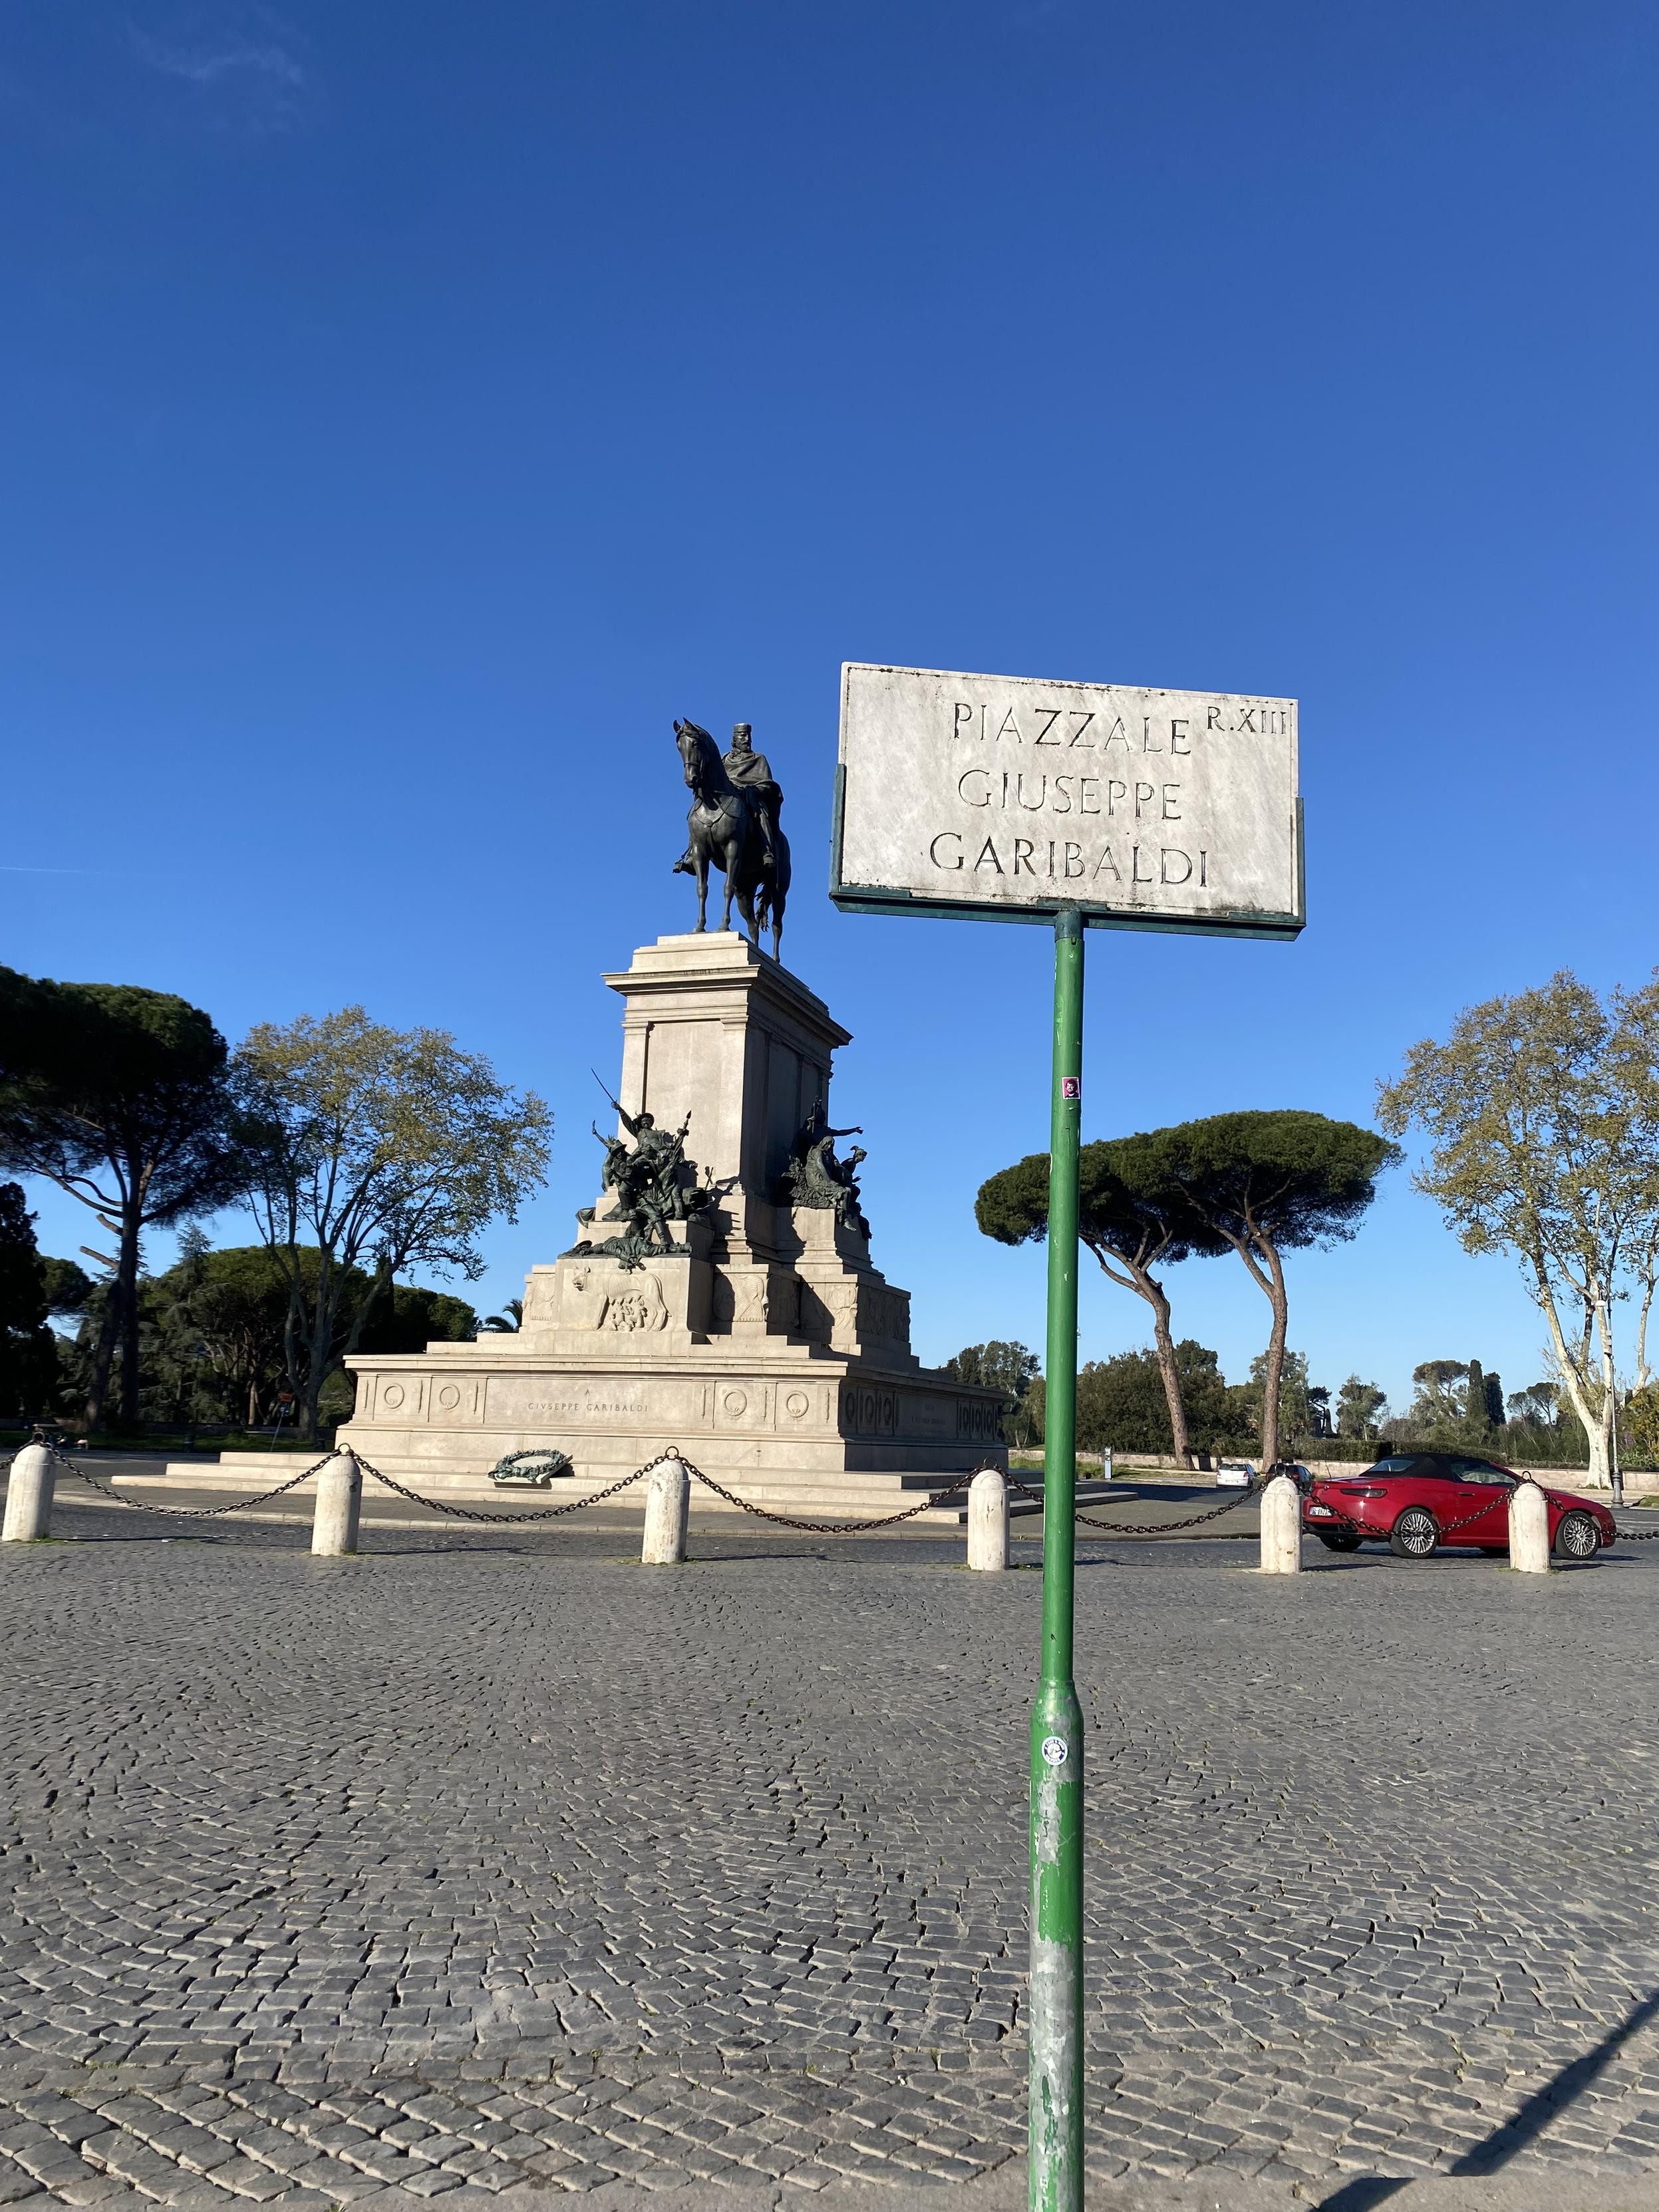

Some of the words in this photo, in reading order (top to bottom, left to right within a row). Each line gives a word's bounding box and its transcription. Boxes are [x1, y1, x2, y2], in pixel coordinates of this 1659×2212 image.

[953, 702, 1192, 756] PIAZZALE
[1207, 706, 1287, 735] R.XIII
[958, 769, 1182, 821] GIUSEPPE
[929, 832, 1208, 887] GARIBALDI
[528, 1402, 579, 1411] GIVSEPPE
[586, 1404, 647, 1412] GARIBALDI
